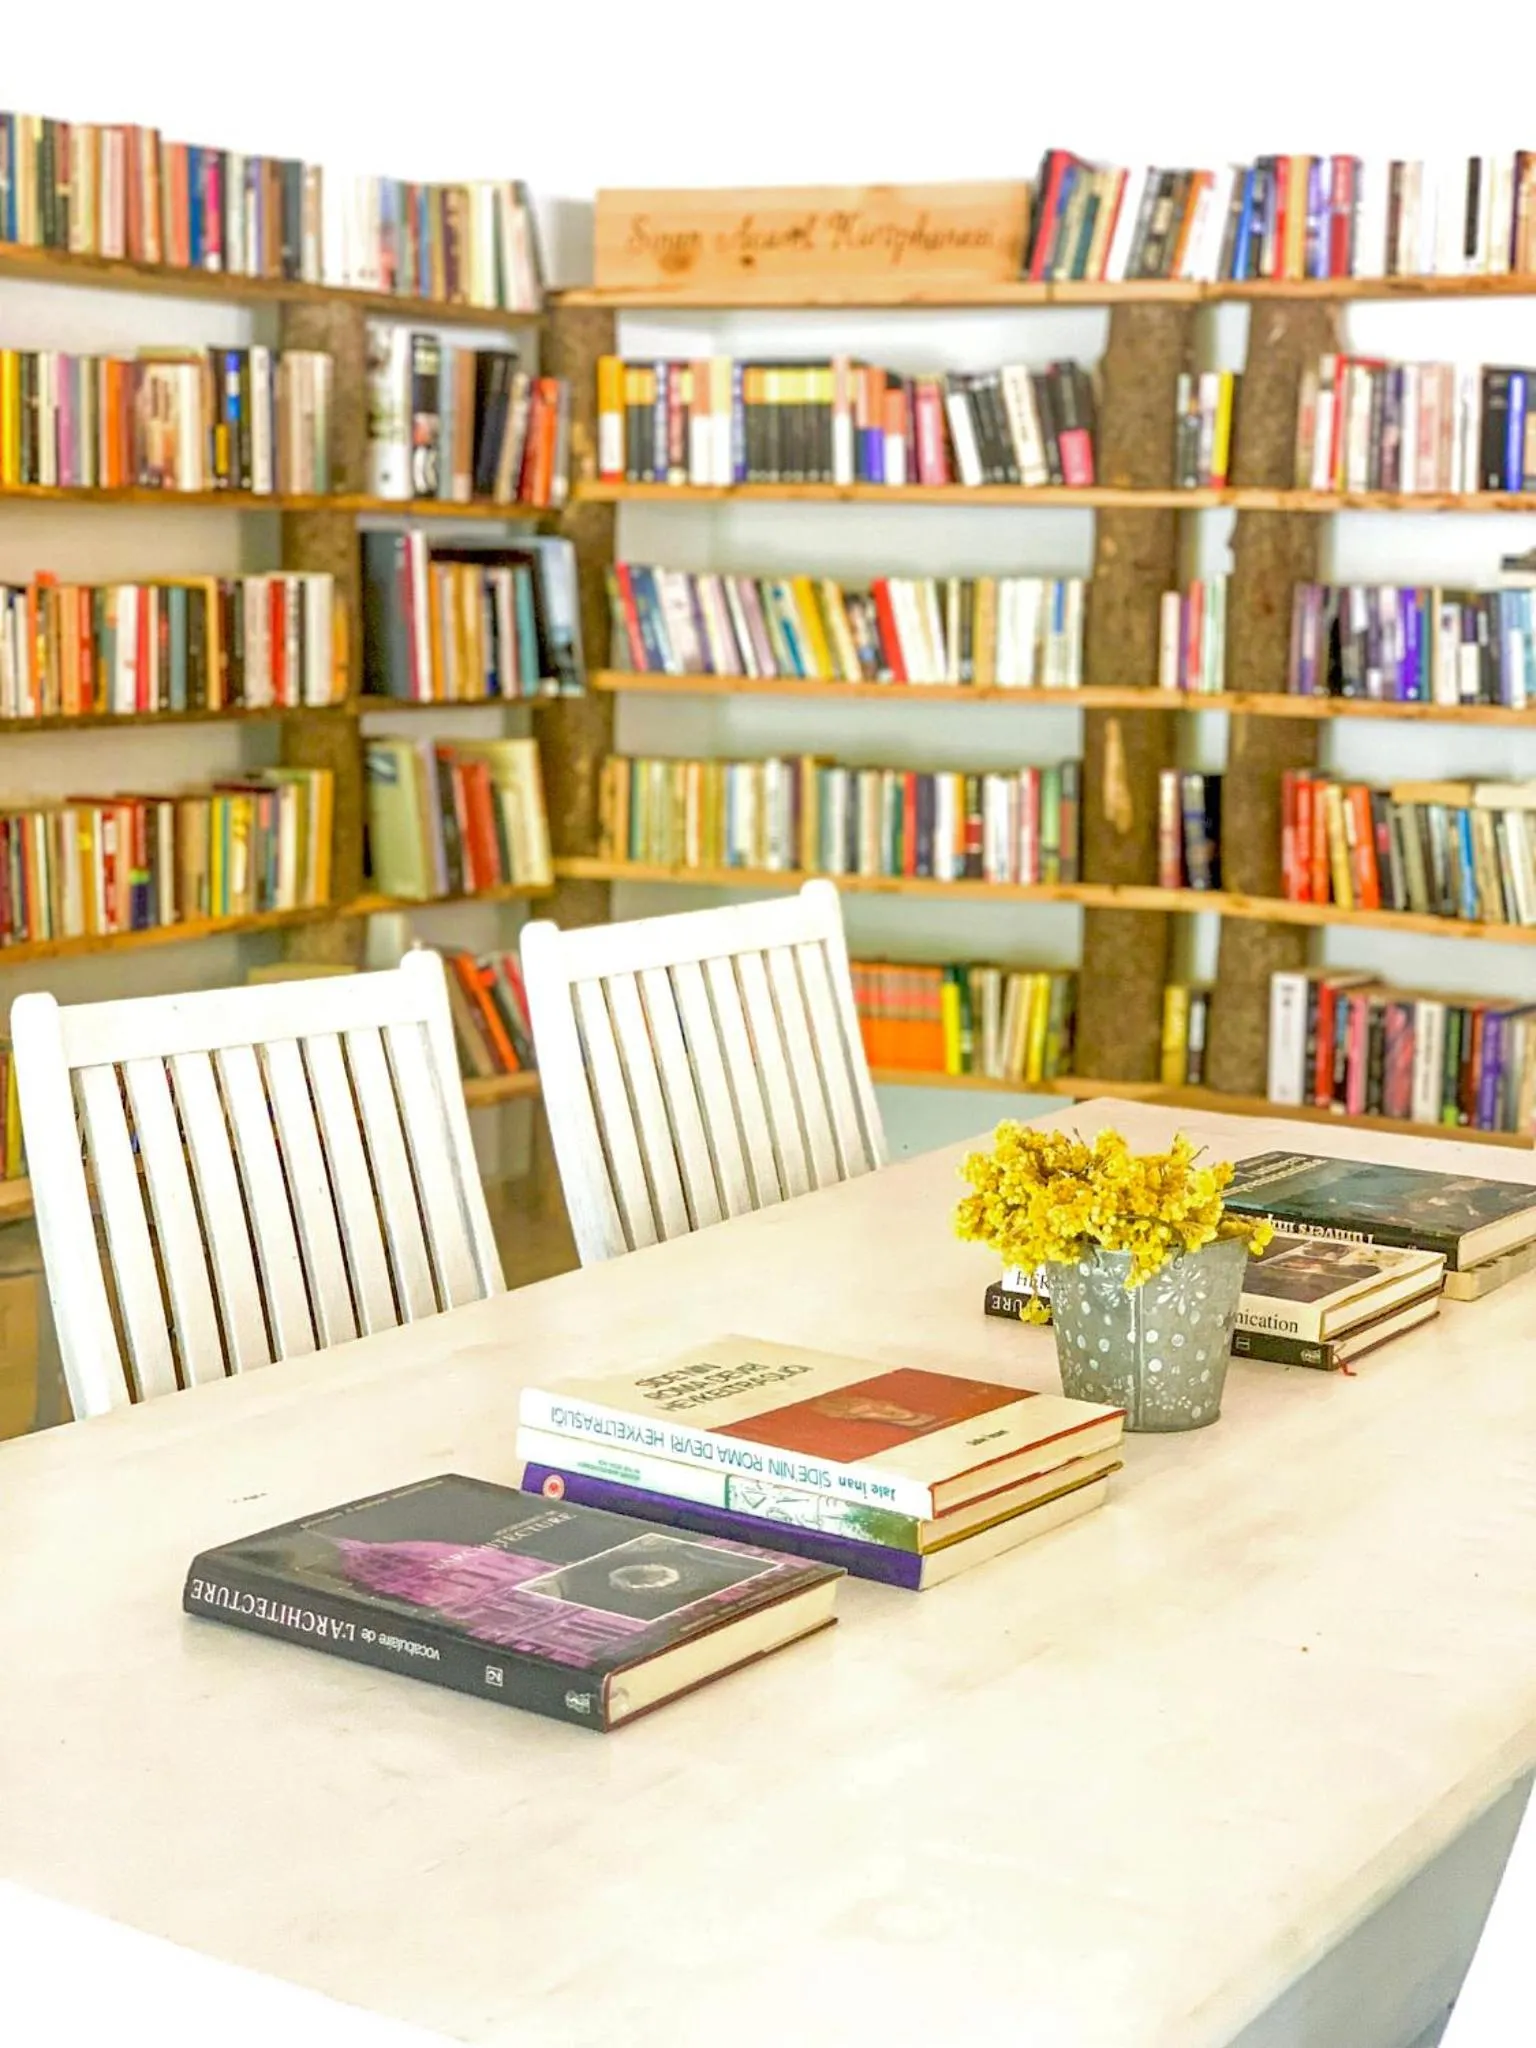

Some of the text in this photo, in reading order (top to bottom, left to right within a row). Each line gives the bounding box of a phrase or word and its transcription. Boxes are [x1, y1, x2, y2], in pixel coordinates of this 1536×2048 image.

[716, 1445, 764, 1472] ROMA
[871, 1485, 897, 1502] Jale
[190, 1578, 441, 1661] vocabulaire de L'ARCHITECTURE
